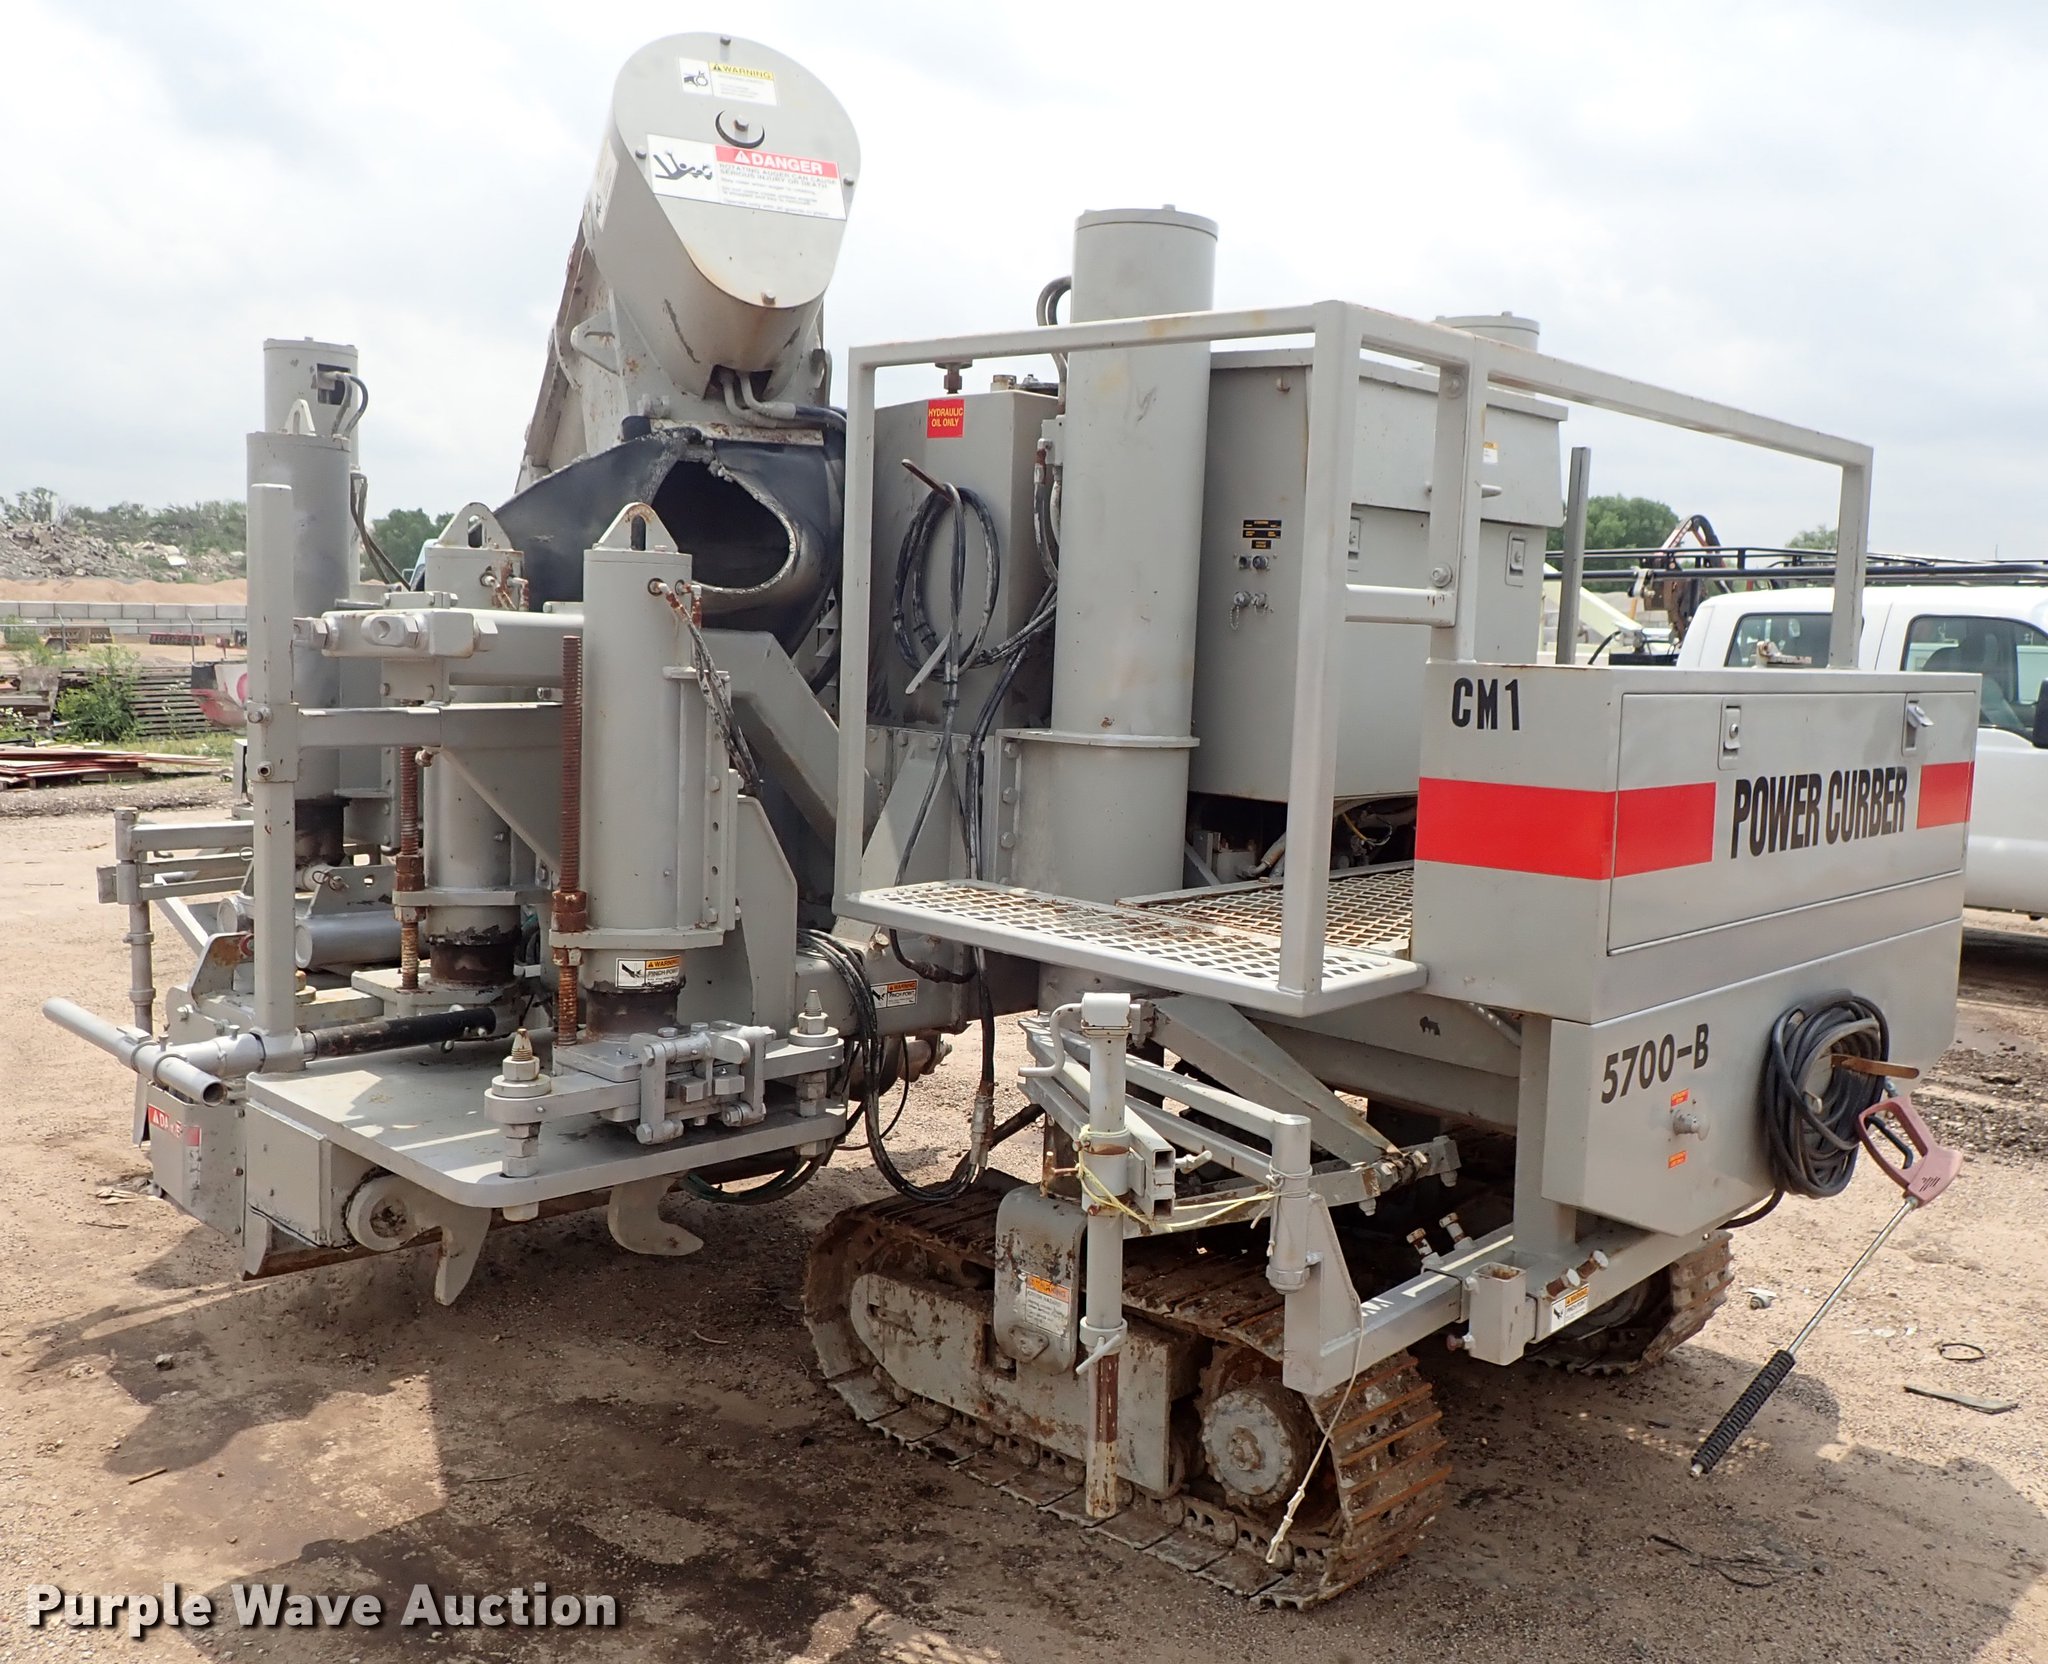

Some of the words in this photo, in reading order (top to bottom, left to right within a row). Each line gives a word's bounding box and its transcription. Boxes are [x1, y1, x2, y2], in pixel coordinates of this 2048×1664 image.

[723, 65, 771, 79] WARNING
[720, 163, 760, 175] ROTATING
[751, 152, 823, 175] DANGER
[720, 169, 756, 180] SERIOUS
[757, 174, 785, 183] INJURY
[801, 179, 828, 189] DEATH
[928, 407, 964, 417] HYDRAULIC
[931, 418, 942, 427] OIL
[942, 417, 960, 427] ONLY
[1452, 677, 1520, 731] CM1
[1731, 773, 1822, 859] POWER
[1825, 766, 1907, 845] CURBER
[1601, 1023, 1709, 1104] 5700-B
